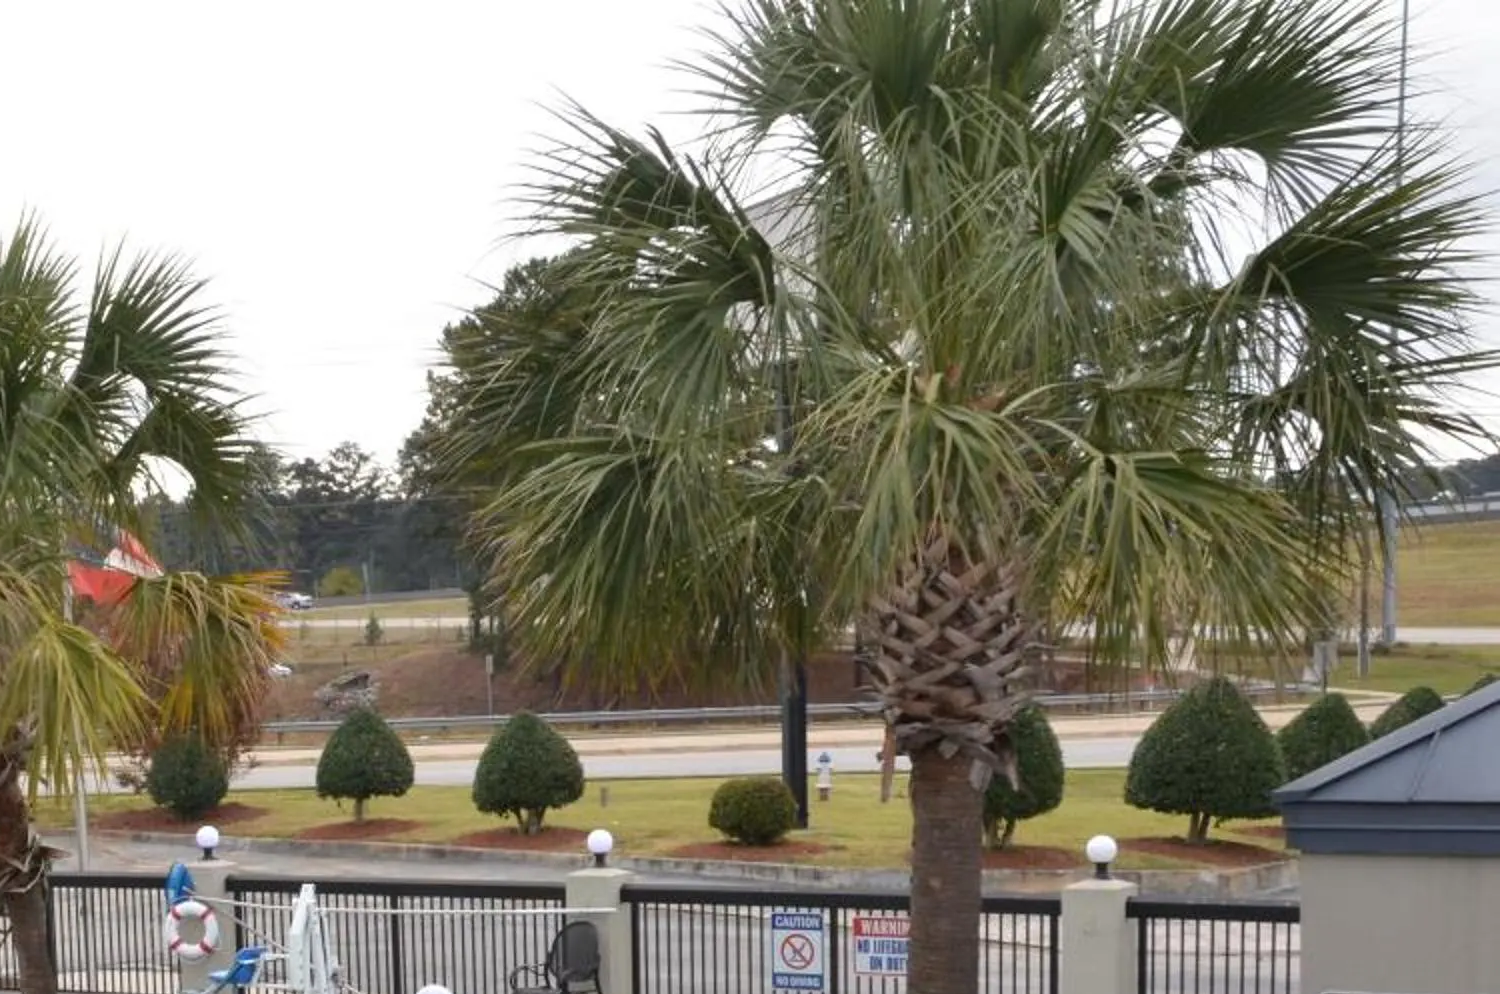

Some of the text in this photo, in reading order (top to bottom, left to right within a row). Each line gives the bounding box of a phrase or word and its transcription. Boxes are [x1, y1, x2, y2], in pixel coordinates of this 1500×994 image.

[775, 915, 820, 928] CAUTION
[862, 920, 911, 936] WARNIN
[858, 939, 869, 953] NO
[869, 956, 908, 970] ON DUT
[775, 976, 821, 987] NO DIVING
